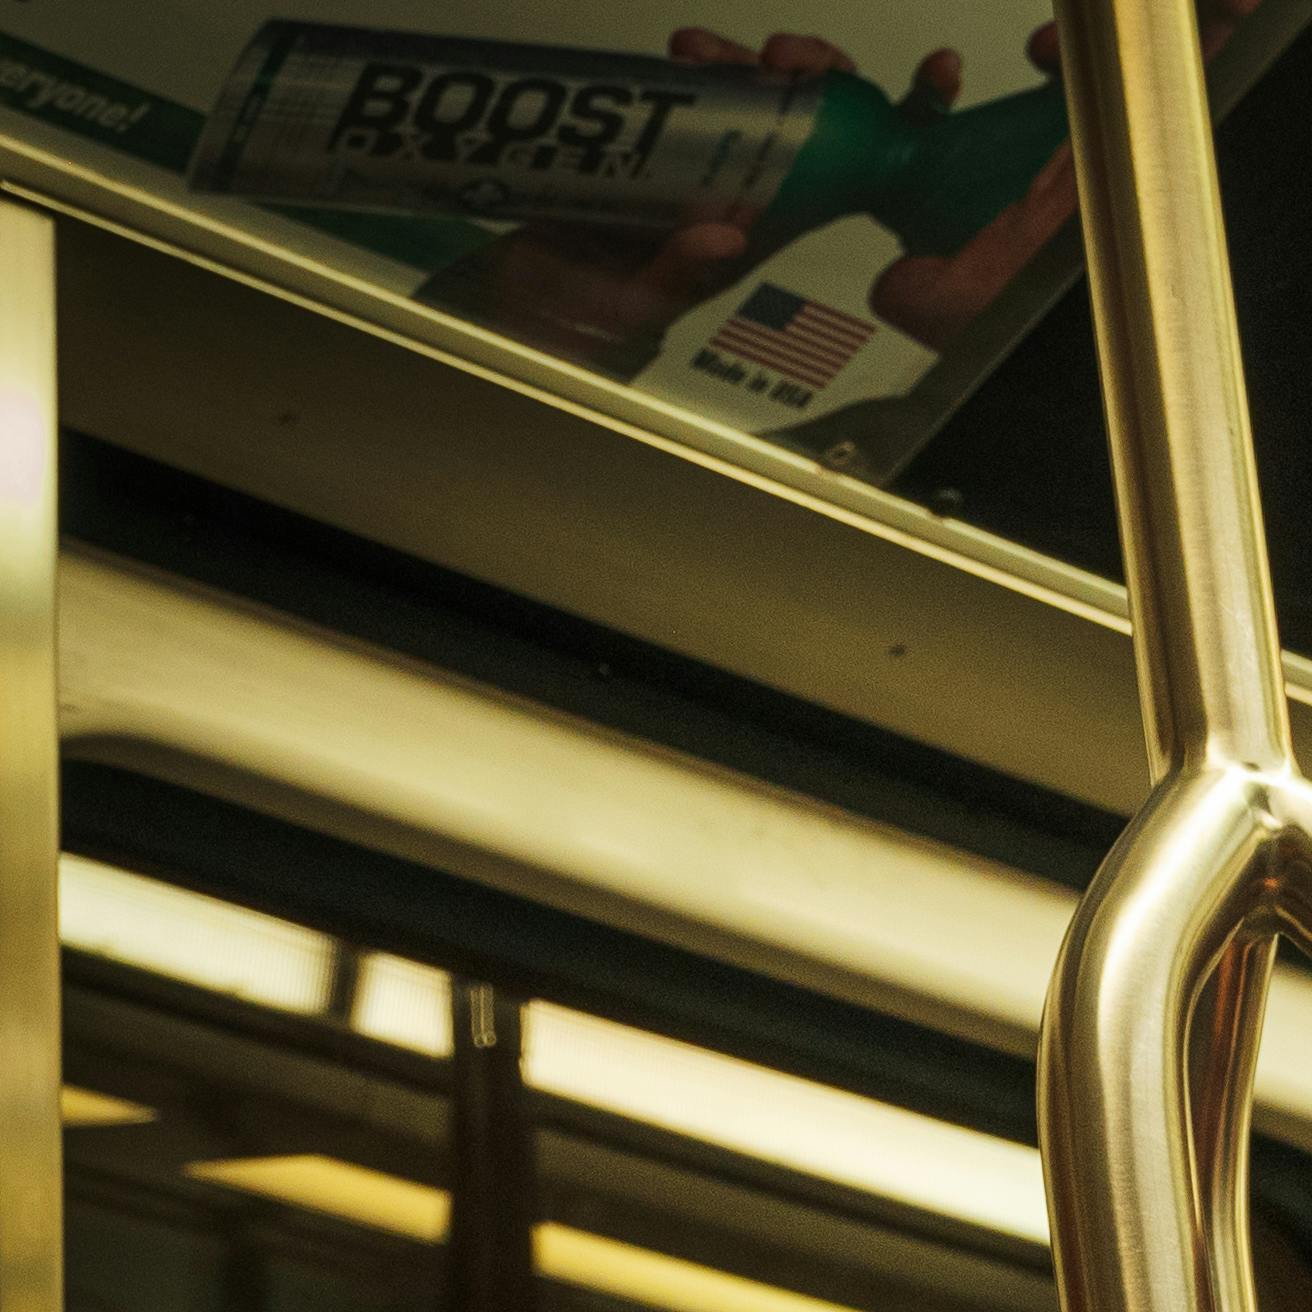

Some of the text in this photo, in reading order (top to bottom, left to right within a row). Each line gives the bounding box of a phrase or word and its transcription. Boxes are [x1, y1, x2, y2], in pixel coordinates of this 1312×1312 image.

[0, 57, 151, 134] eryone!
[328, 63, 696, 179] BOOST
[337, 127, 648, 180] OXYGEN
